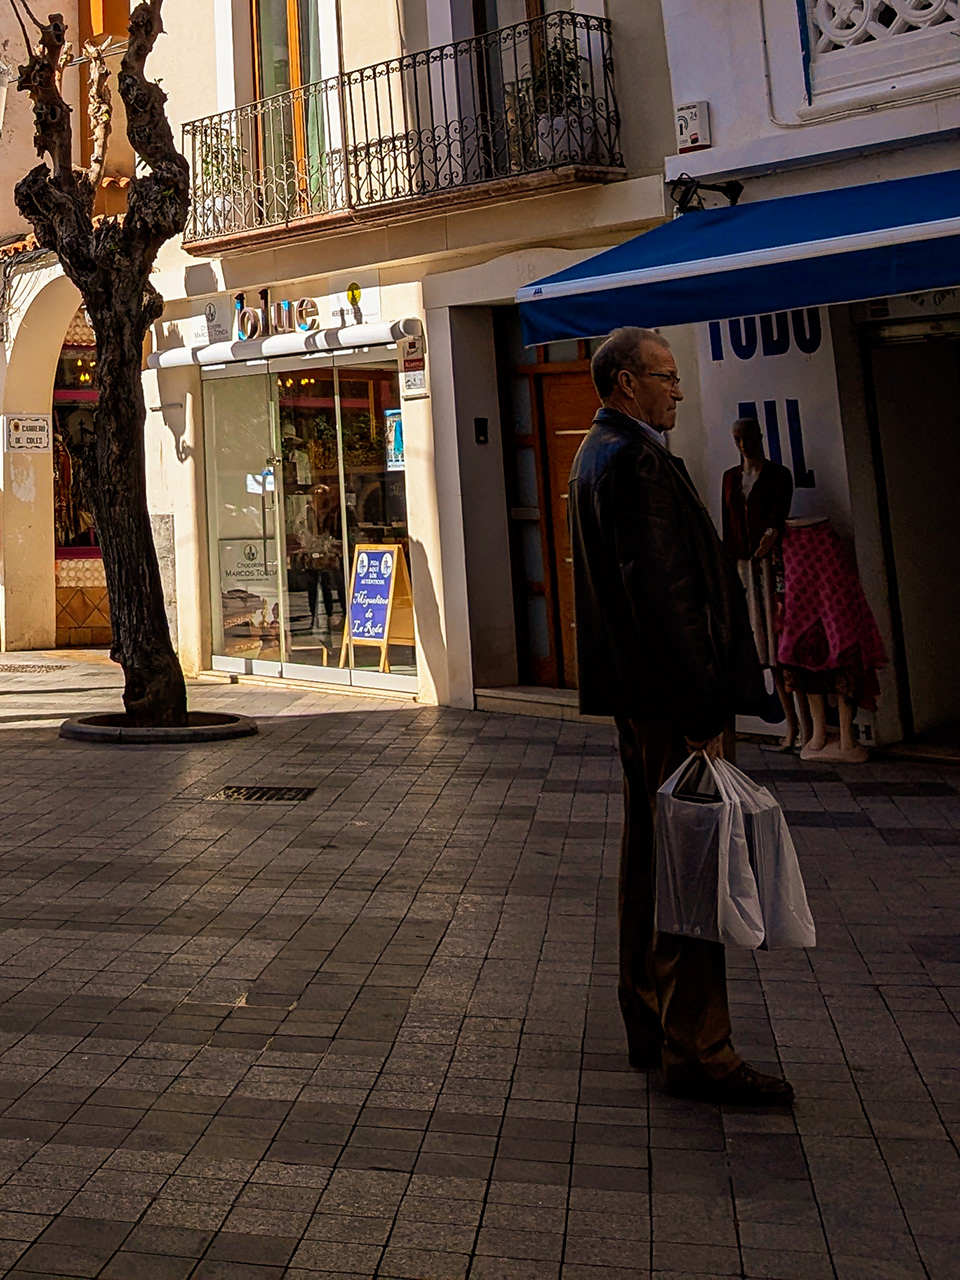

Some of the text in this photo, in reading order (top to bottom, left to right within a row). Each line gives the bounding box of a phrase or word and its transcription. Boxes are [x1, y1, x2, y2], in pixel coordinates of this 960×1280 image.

[234, 286, 321, 343] blue
[26, 436, 43, 445] COLES
[225, 569, 255, 578] MARCOS
